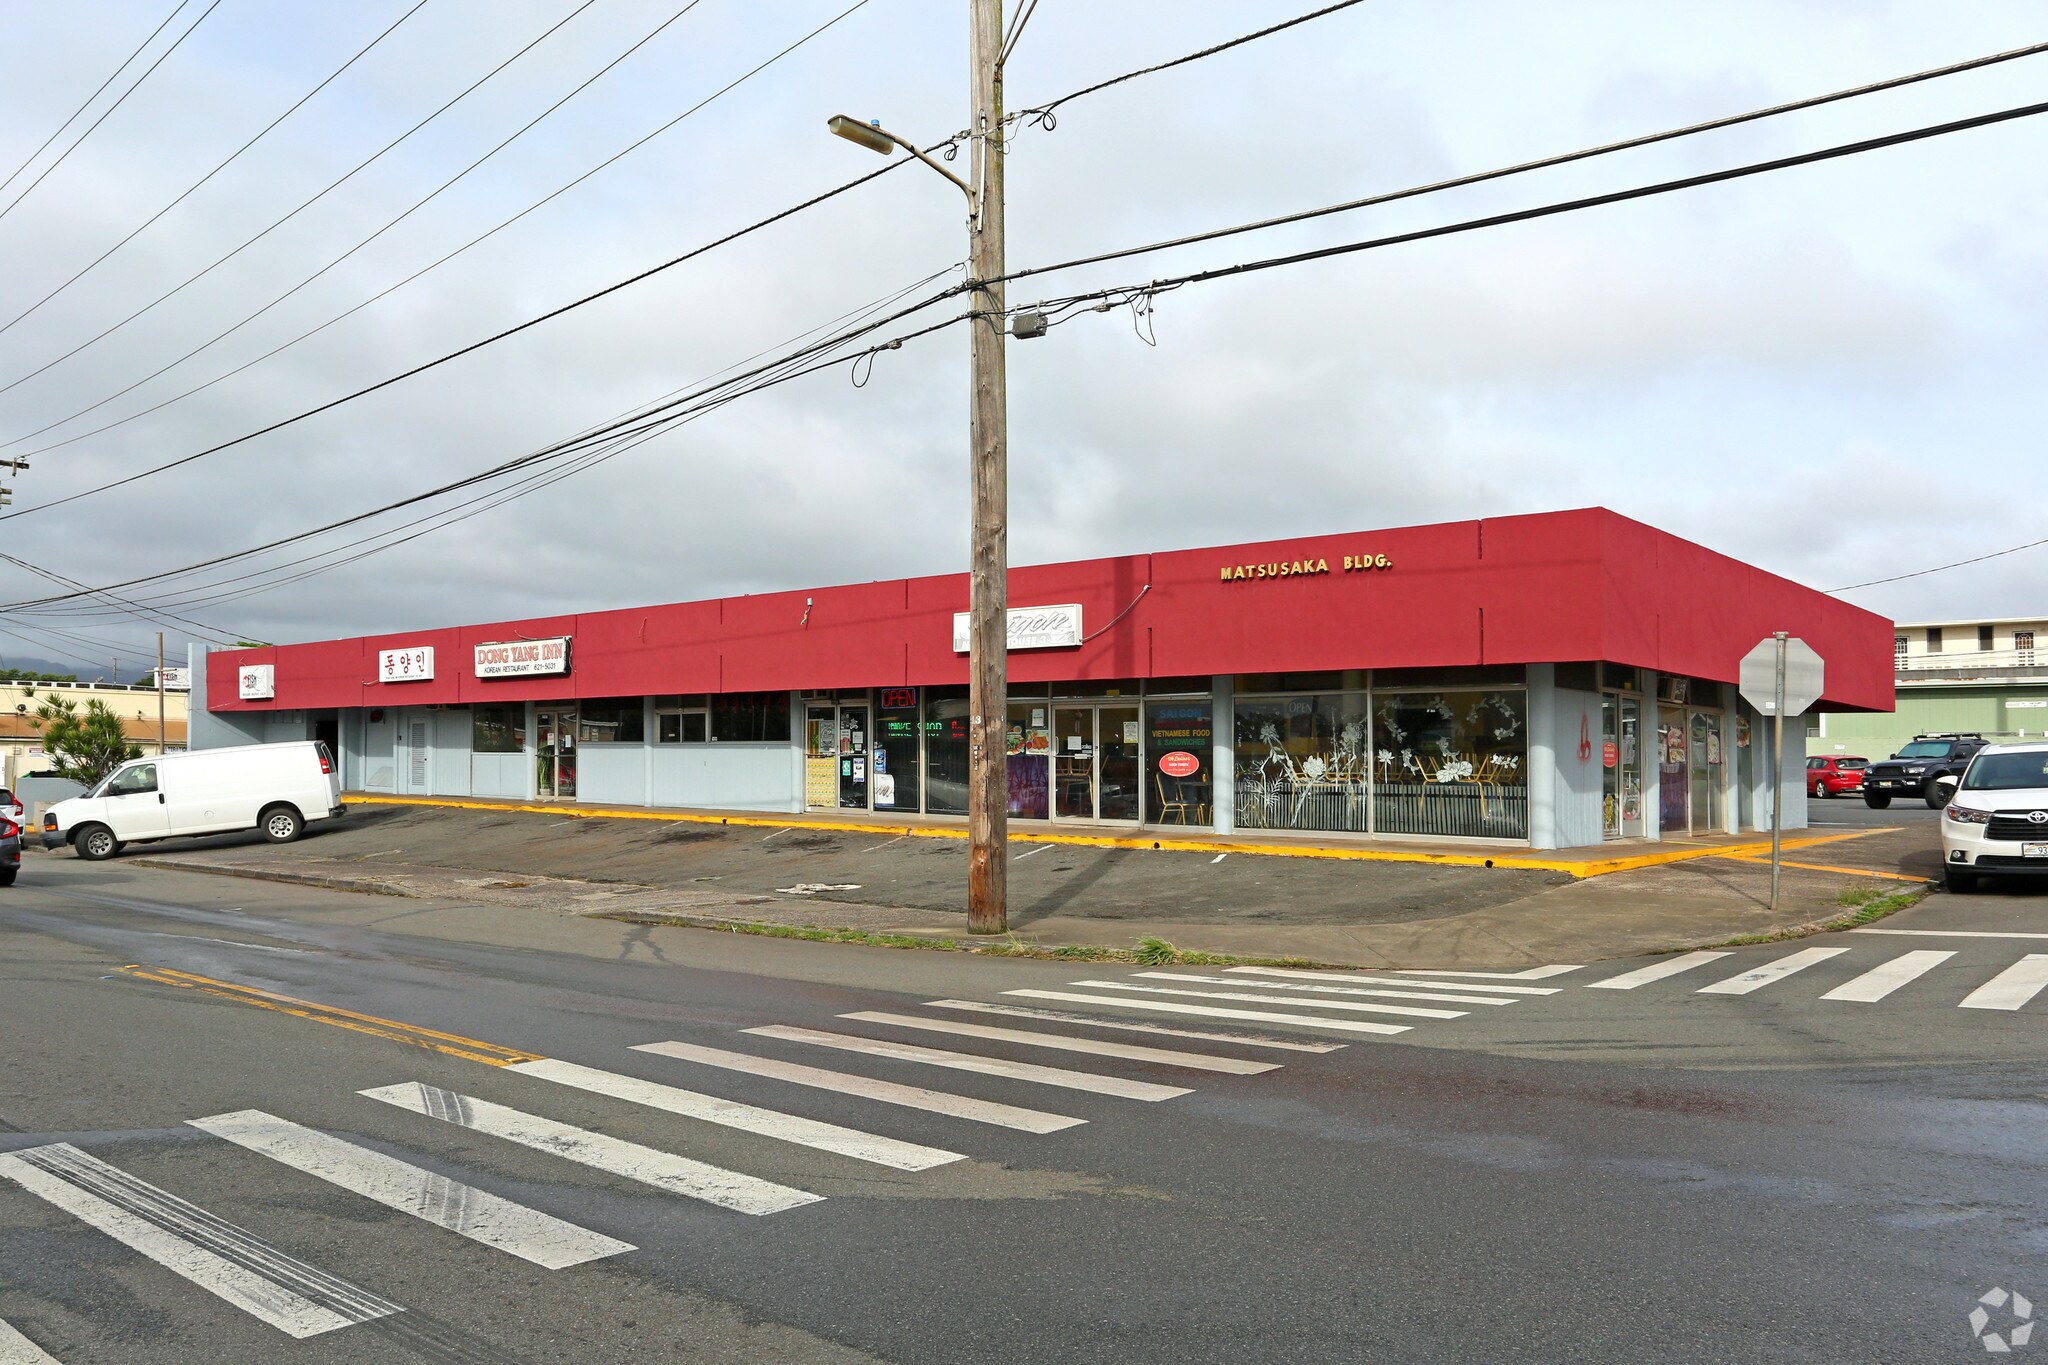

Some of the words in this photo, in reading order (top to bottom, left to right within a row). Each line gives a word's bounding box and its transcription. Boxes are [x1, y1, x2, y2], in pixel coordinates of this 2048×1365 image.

[1220, 558, 1328, 580] MATSUSAKA
[1343, 553, 1392, 570] BLDG.
[478, 647, 509, 665] DONG
[511, 645, 539, 662] YANG
[541, 643, 563, 660] INN
[484, 666, 502, 674] KOREAN
[503, 664, 530, 673] RESTAURANT
[882, 690, 915, 707] OPEN
[1288, 702, 1313, 713] OPEN
[1160, 708, 1202, 719] SAIGON
[1152, 729, 1191, 738] VIETNAMESE
[1192, 729, 1210, 737] FOOD
[1165, 738, 1206, 746] SANDWICHES
